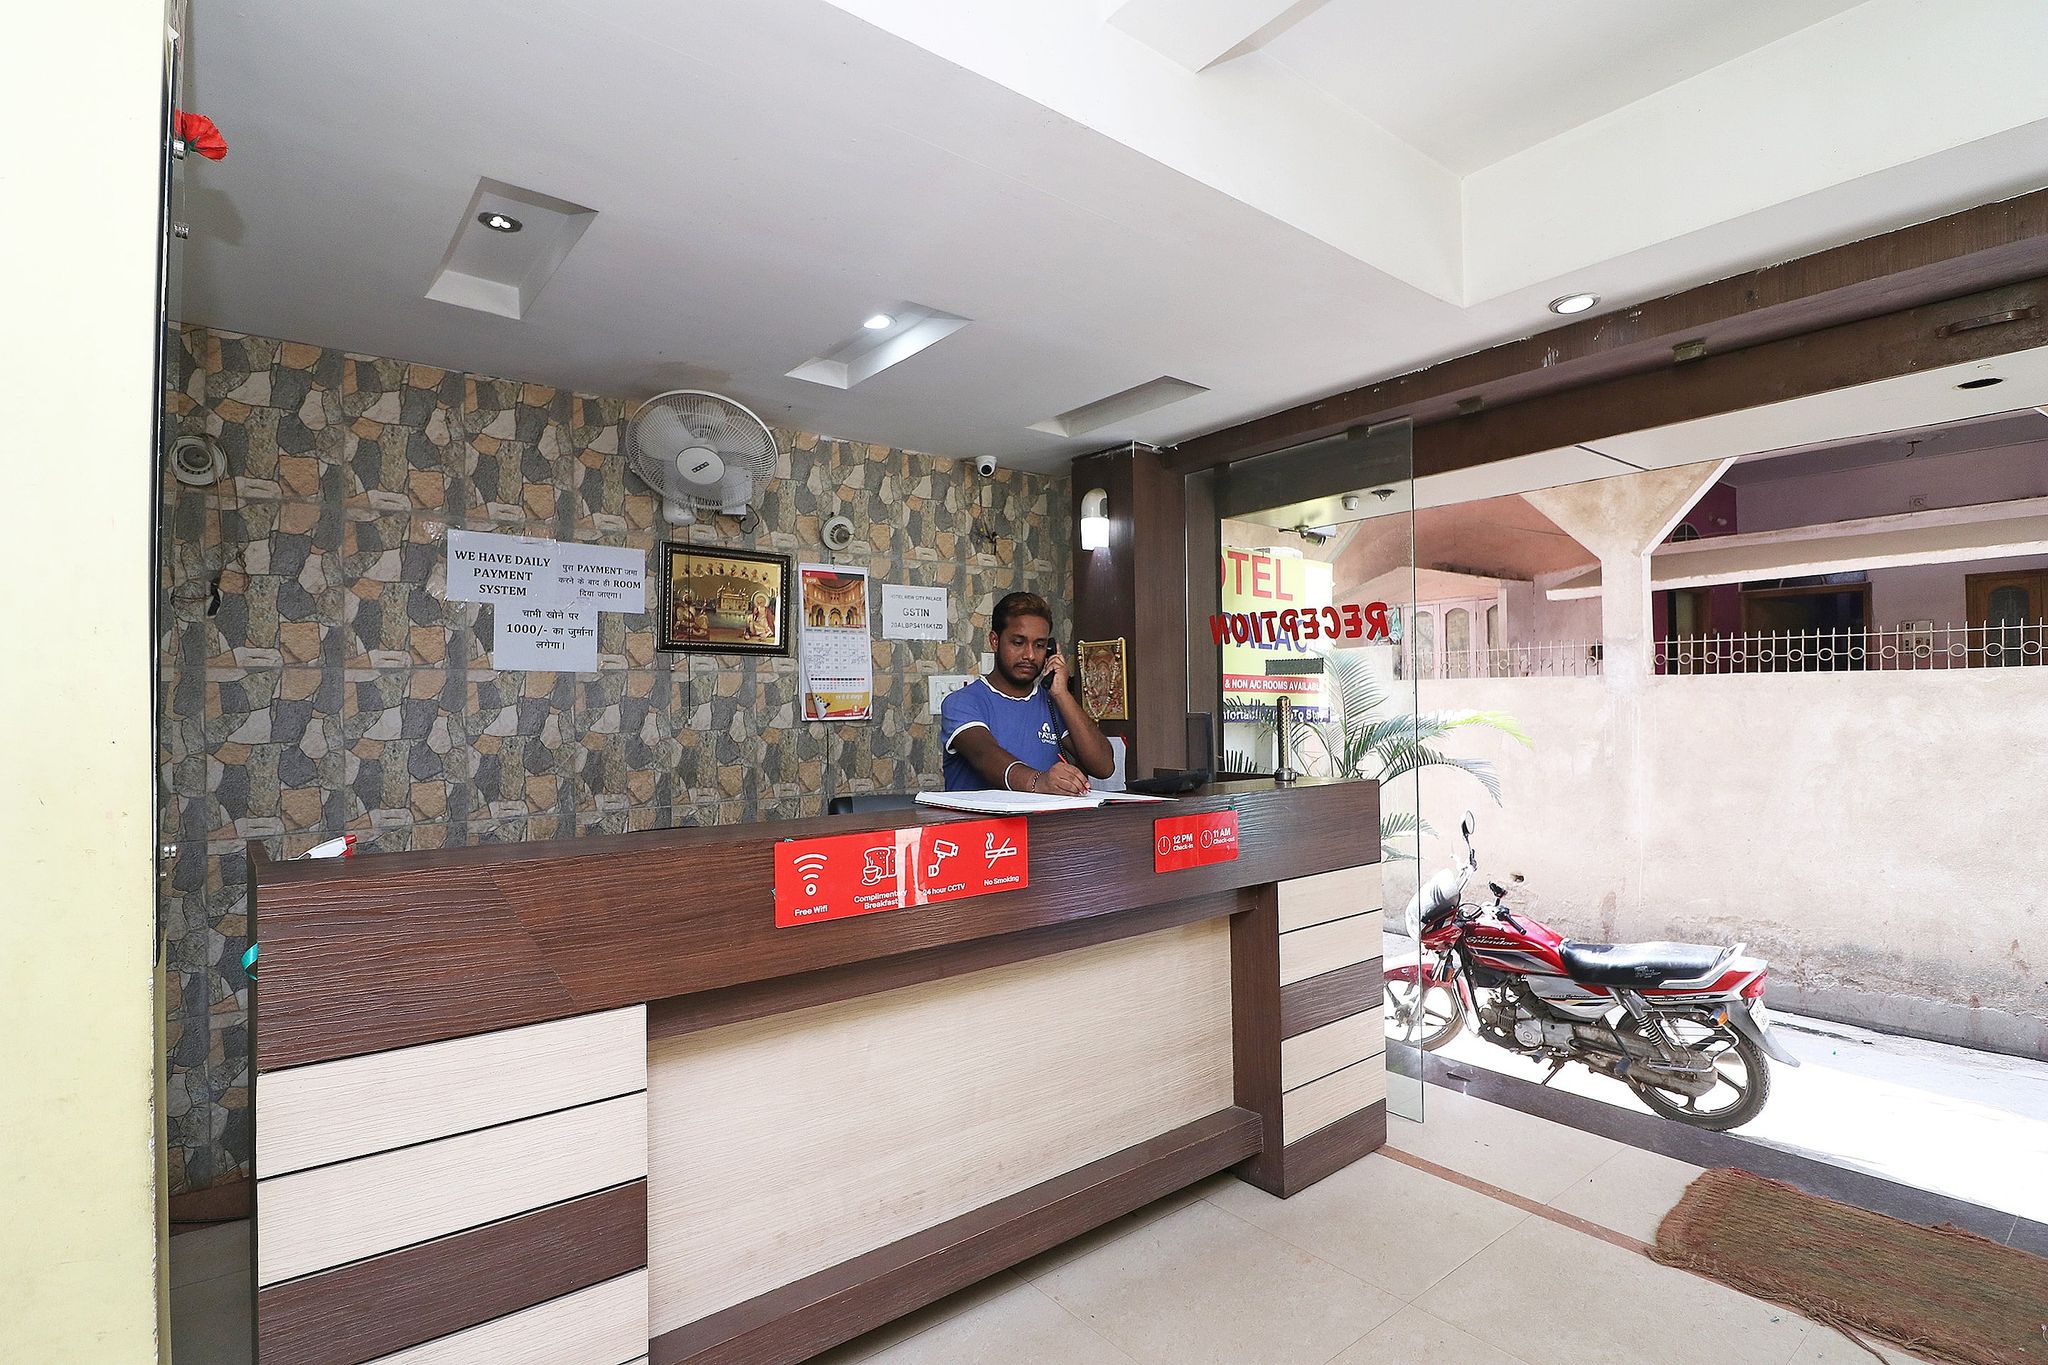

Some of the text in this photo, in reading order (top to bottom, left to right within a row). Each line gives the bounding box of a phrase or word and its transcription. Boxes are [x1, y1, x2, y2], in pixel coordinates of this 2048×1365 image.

[455, 550, 551, 567] WE HAVE DAILY
[473, 567, 533, 581] PAYMENT
[577, 564, 622, 575] PAYMENT
[479, 584, 527, 596] SYSTEM
[613, 580, 641, 589] ROOM
[568, 612, 579, 620] पर
[902, 607, 930, 617] GSTIN
[506, 623, 547, 636] 1000/-
[552, 627, 563, 635] का
[1224, 679, 1231, 689] &
[1231, 679, 1248, 689] NON
[1262, 681, 1288, 691] ROOMS
[1172, 833, 1193, 845] 12 PM
[1212, 827, 1232, 839] 11 AM
[1212, 836, 1236, 845] Check-out
[1172, 843, 1194, 852] Check-in
[983, 875, 1020, 887] No Smoking
[931, 886, 947, 896] hour
[947, 883, 966, 893] CCTV
[864, 898, 900, 910] Breakfast
[794, 904, 829, 917] Free Wifi
